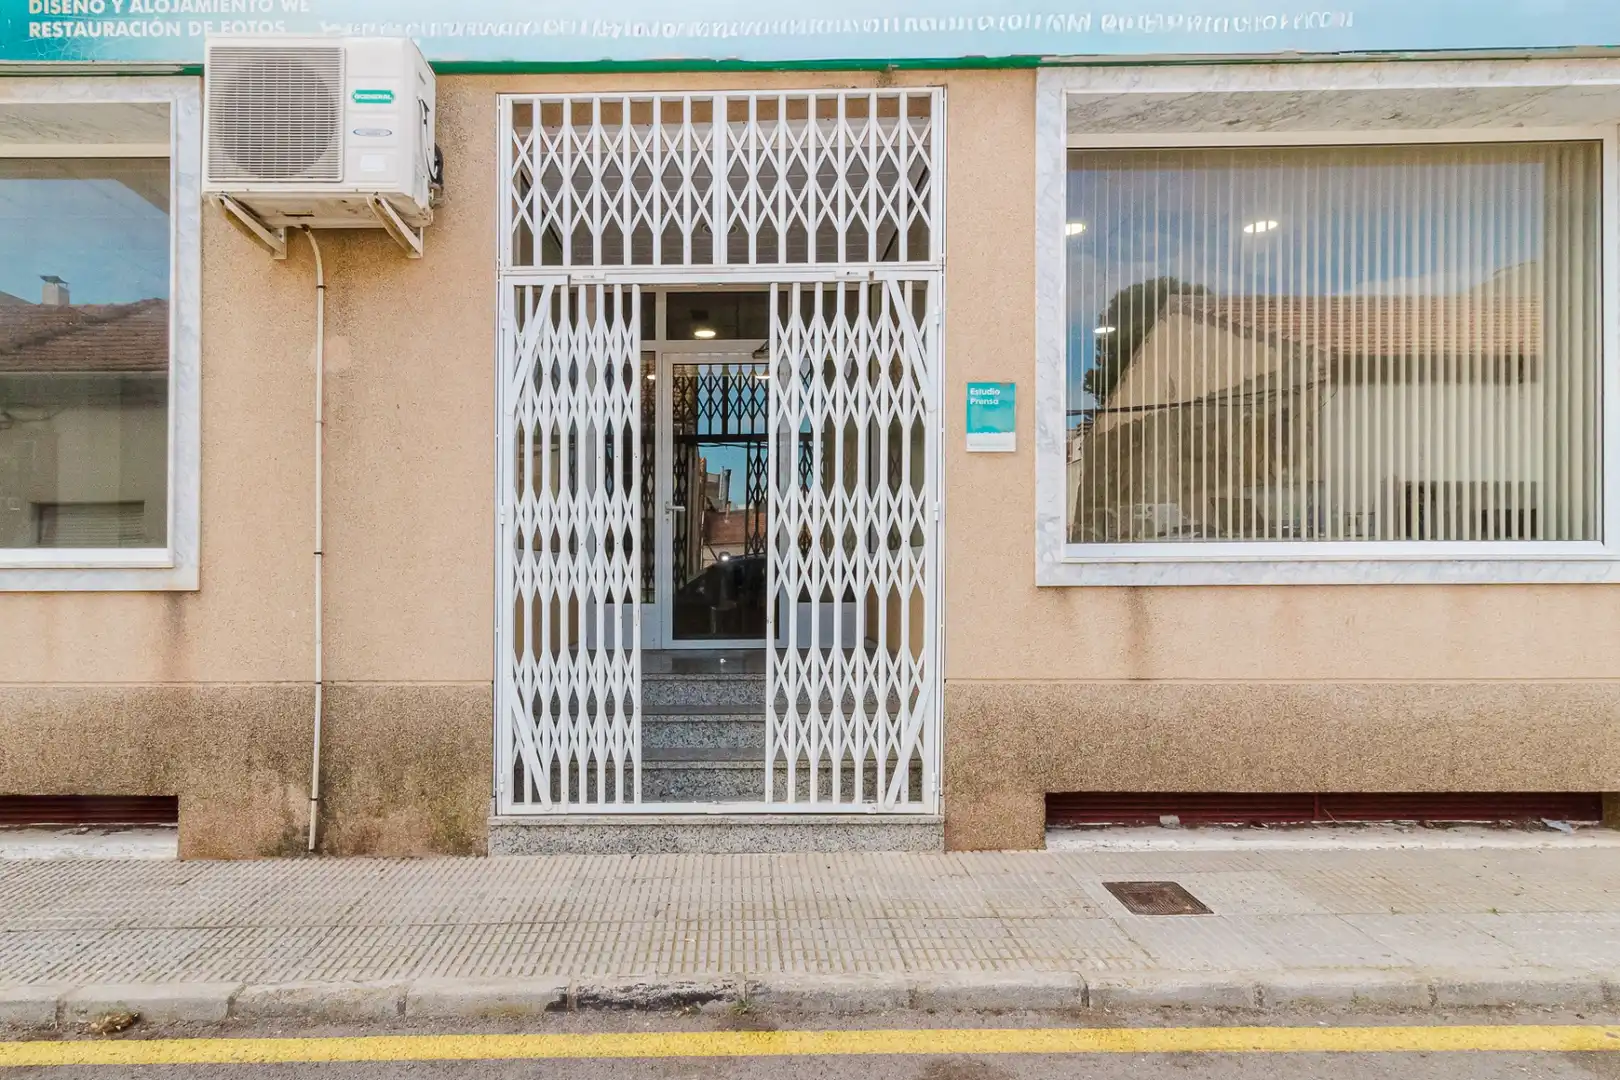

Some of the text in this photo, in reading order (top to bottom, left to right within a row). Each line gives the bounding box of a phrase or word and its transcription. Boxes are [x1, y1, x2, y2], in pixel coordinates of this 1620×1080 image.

[111, 0, 125, 14] Y
[129, 0, 275, 13] ALOJAMIENTO
[28, 17, 286, 38] RESTAURACIÓN DE FOTOS
[970, 387, 1001, 396] Estudio
